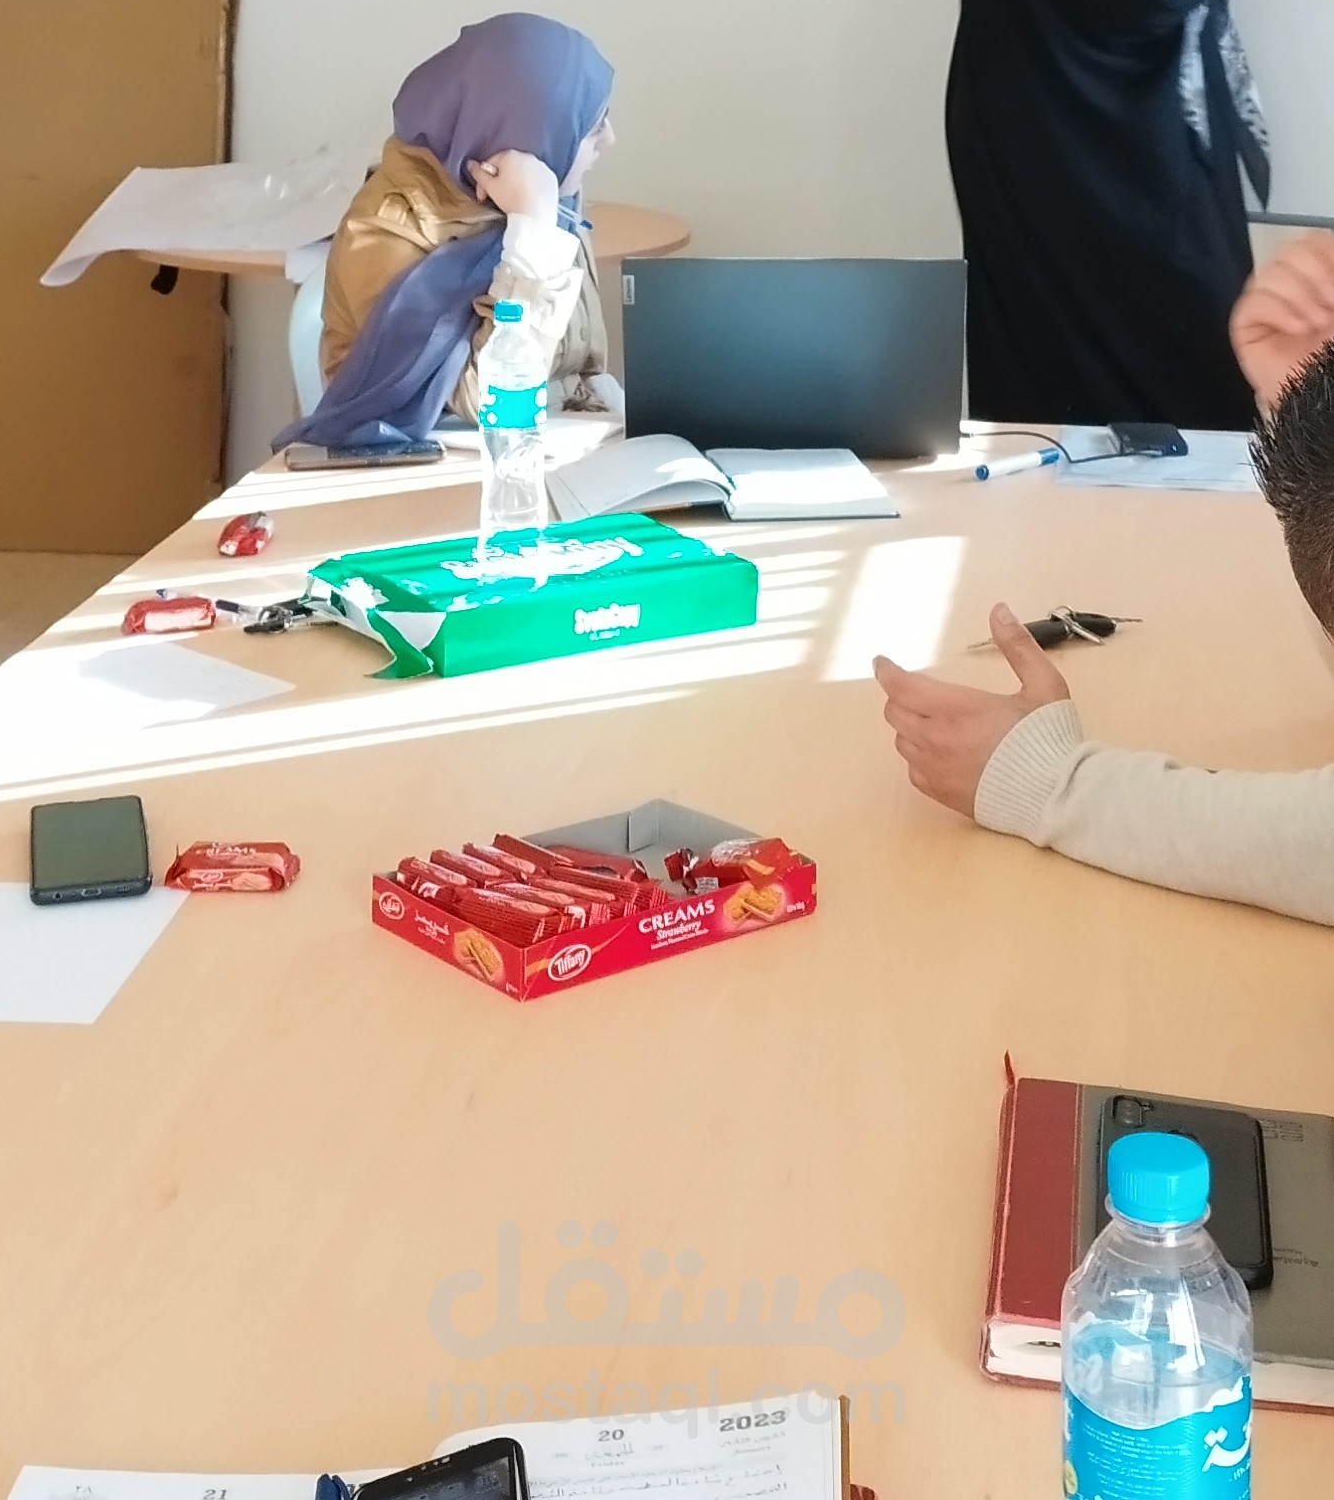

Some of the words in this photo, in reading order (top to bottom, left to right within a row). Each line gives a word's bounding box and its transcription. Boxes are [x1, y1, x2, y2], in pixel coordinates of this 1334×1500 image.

[638, 899, 715, 933] CREAMS
[553, 949, 586, 976] Tiffany
[719, 1410, 786, 1432] 2023
[598, 1429, 625, 1442] 20
[202, 1489, 228, 1500] 21
